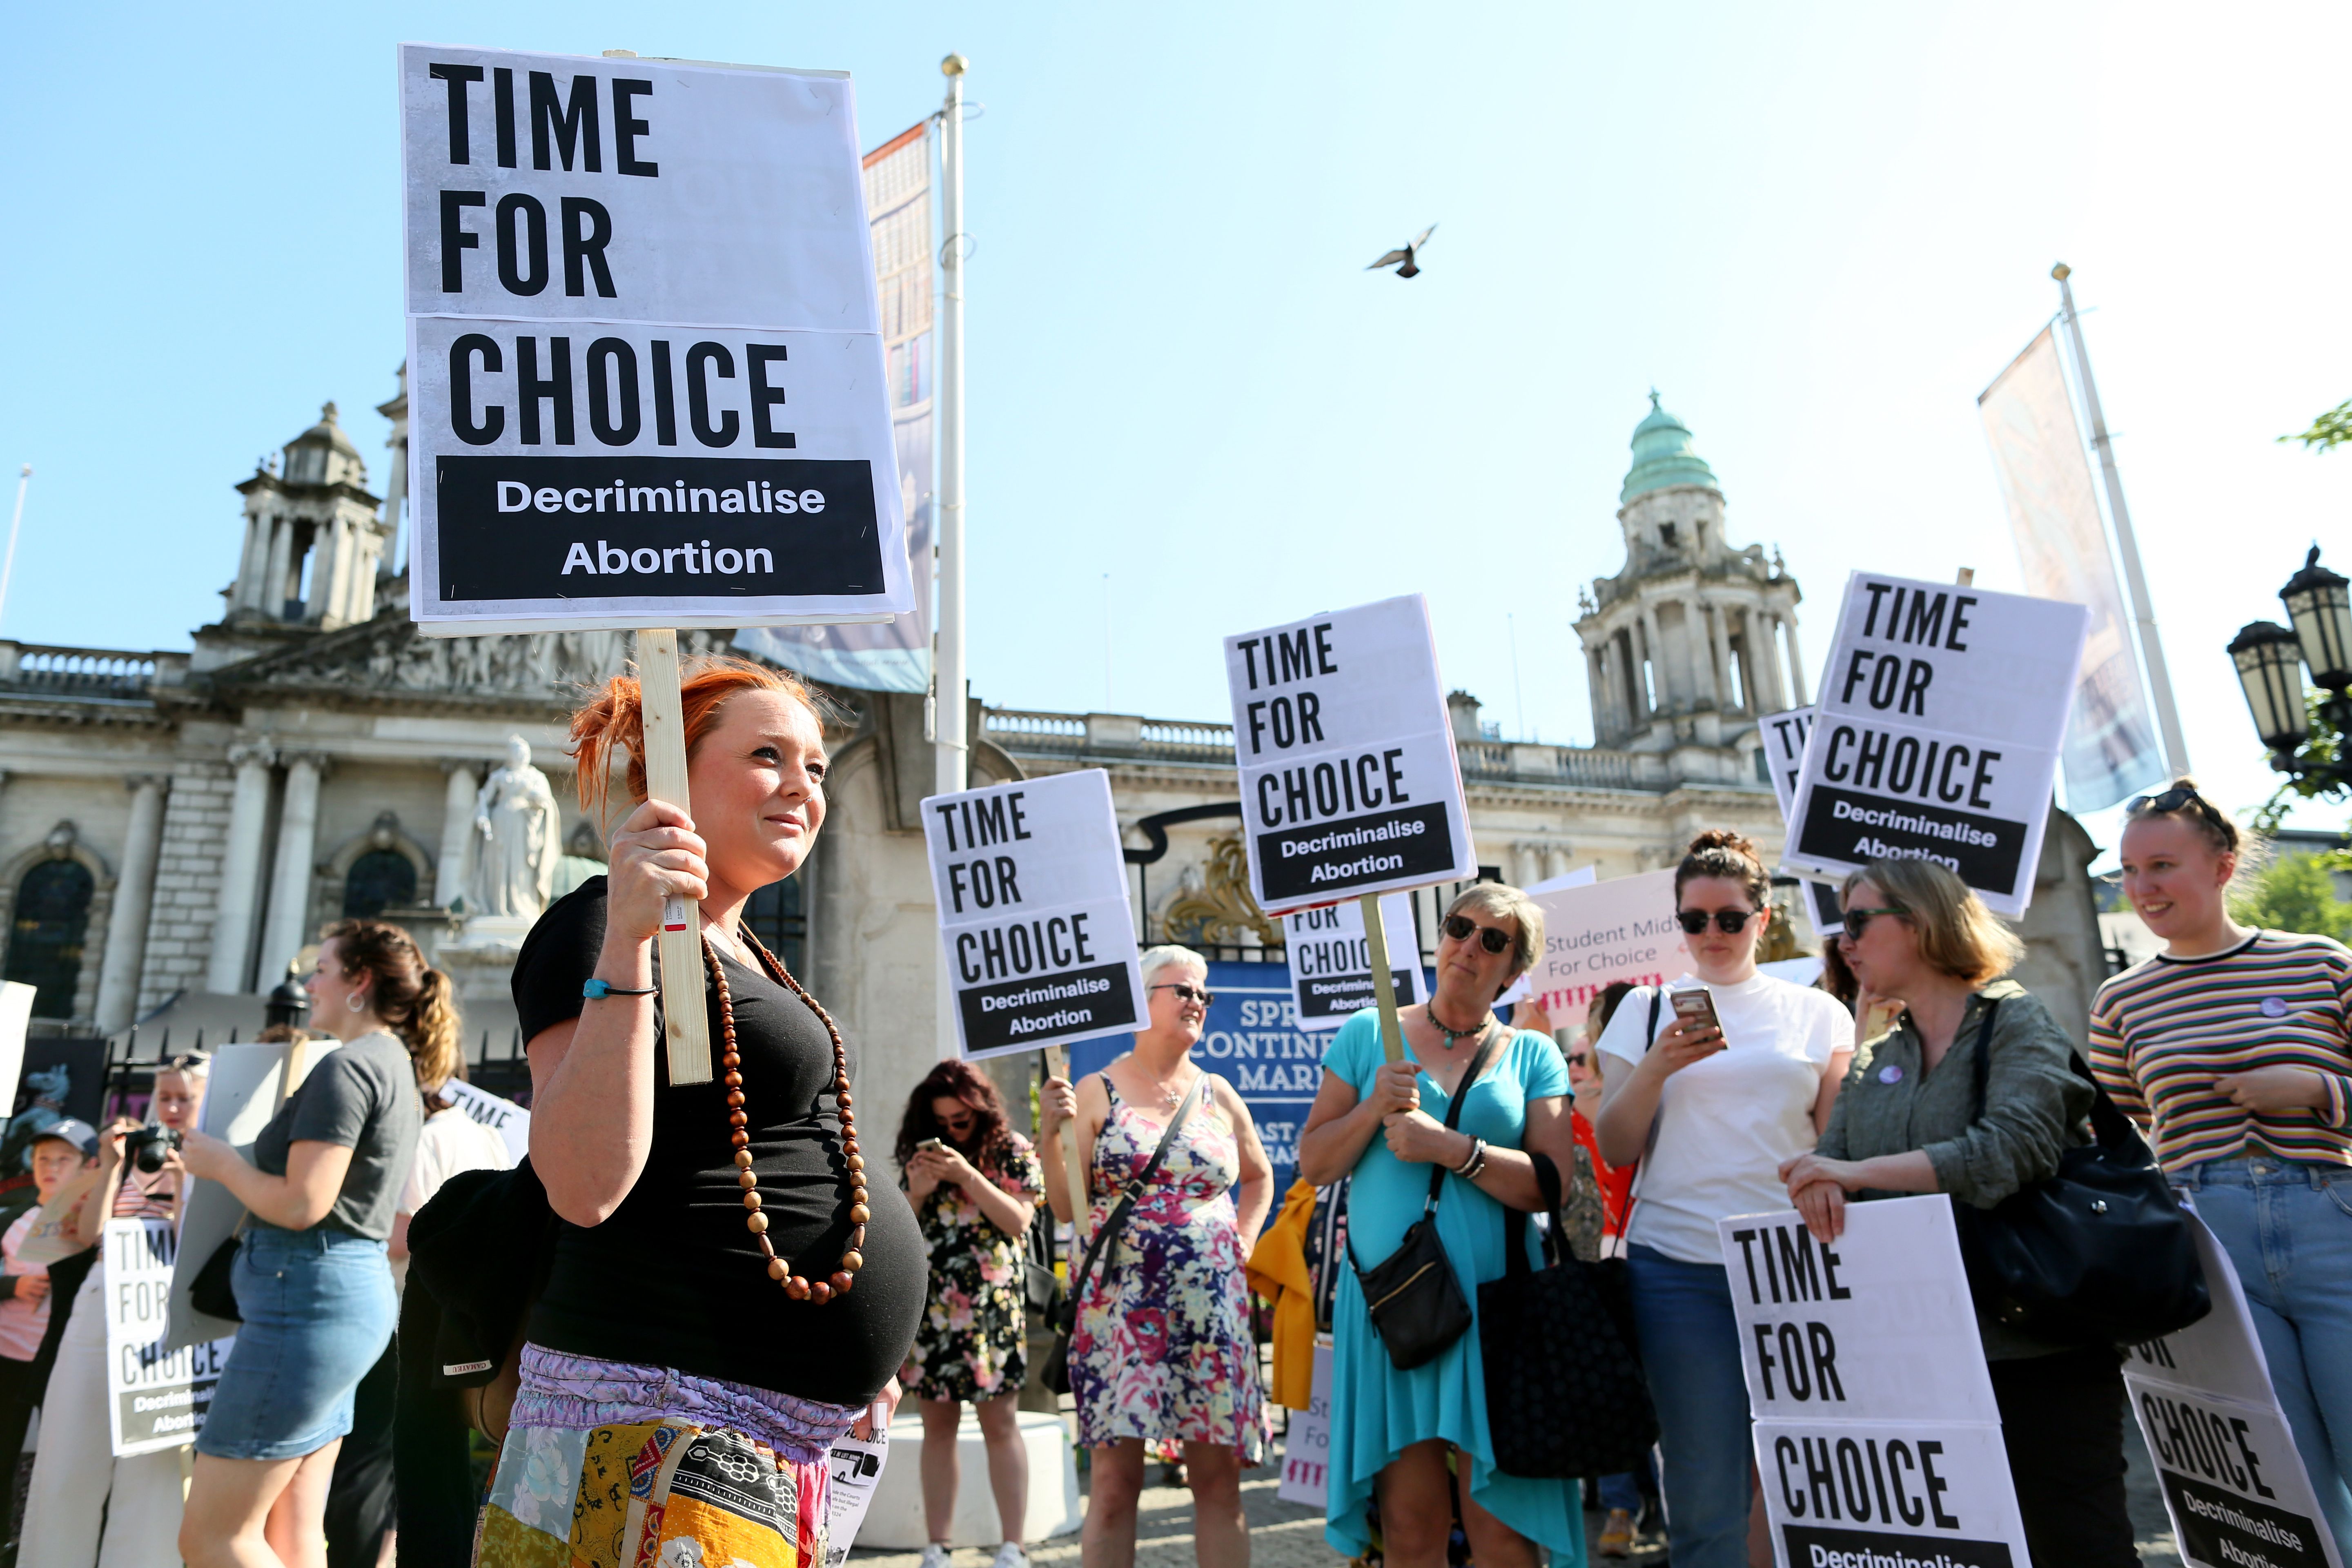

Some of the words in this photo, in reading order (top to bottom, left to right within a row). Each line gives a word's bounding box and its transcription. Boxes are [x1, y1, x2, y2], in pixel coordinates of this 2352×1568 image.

[429, 62, 659, 178] TIME
[440, 190, 617, 298] FOR
[449, 333, 796, 449] CHOICE
[497, 479, 825, 514] Decriminalise
[561, 540, 773, 575] Abortion
[1863, 582, 1978, 652] TIME
[1237, 622, 1338, 690] TIME
[1841, 649, 1933, 717] FOR
[1247, 691, 1325, 754] FOR
[1258, 748, 1409, 827] CHOICE
[1823, 725, 2001, 809] CHOICE
[936, 791, 1031, 852] TIME
[1281, 819, 1425, 858] Decriminalise
[1833, 800, 1998, 848] Decriminalise
[948, 855, 1022, 913] FOR
[1310, 852, 1403, 884] Abortion
[956, 913, 1095, 984] CHOICE
[1298, 938, 1371, 975] CHOIC
[1546, 926, 1628, 954] Student
[1548, 960, 1581, 978] For
[1587, 947, 1657, 971] Choice
[981, 977, 1110, 1012] Decriminalise
[1009, 1007, 1092, 1036] Abortion
[1329, 996, 1378, 1011] Abortio
[453, 1090, 512, 1128] TIME
[115, 1227, 176, 1271] TIM
[1732, 1224, 1851, 1305] TIME
[119, 1281, 169, 1324] FOR
[452, 1361, 487, 1373] CAMAYEU
[1753, 1321, 1846, 1402] FOR
[152, 1411, 207, 1434] Abortio
[2140, 1391, 2276, 1501] CHOICE
[1775, 1435, 1960, 1530] CHOICE
[2182, 1489, 2304, 1552] Decriminalise
